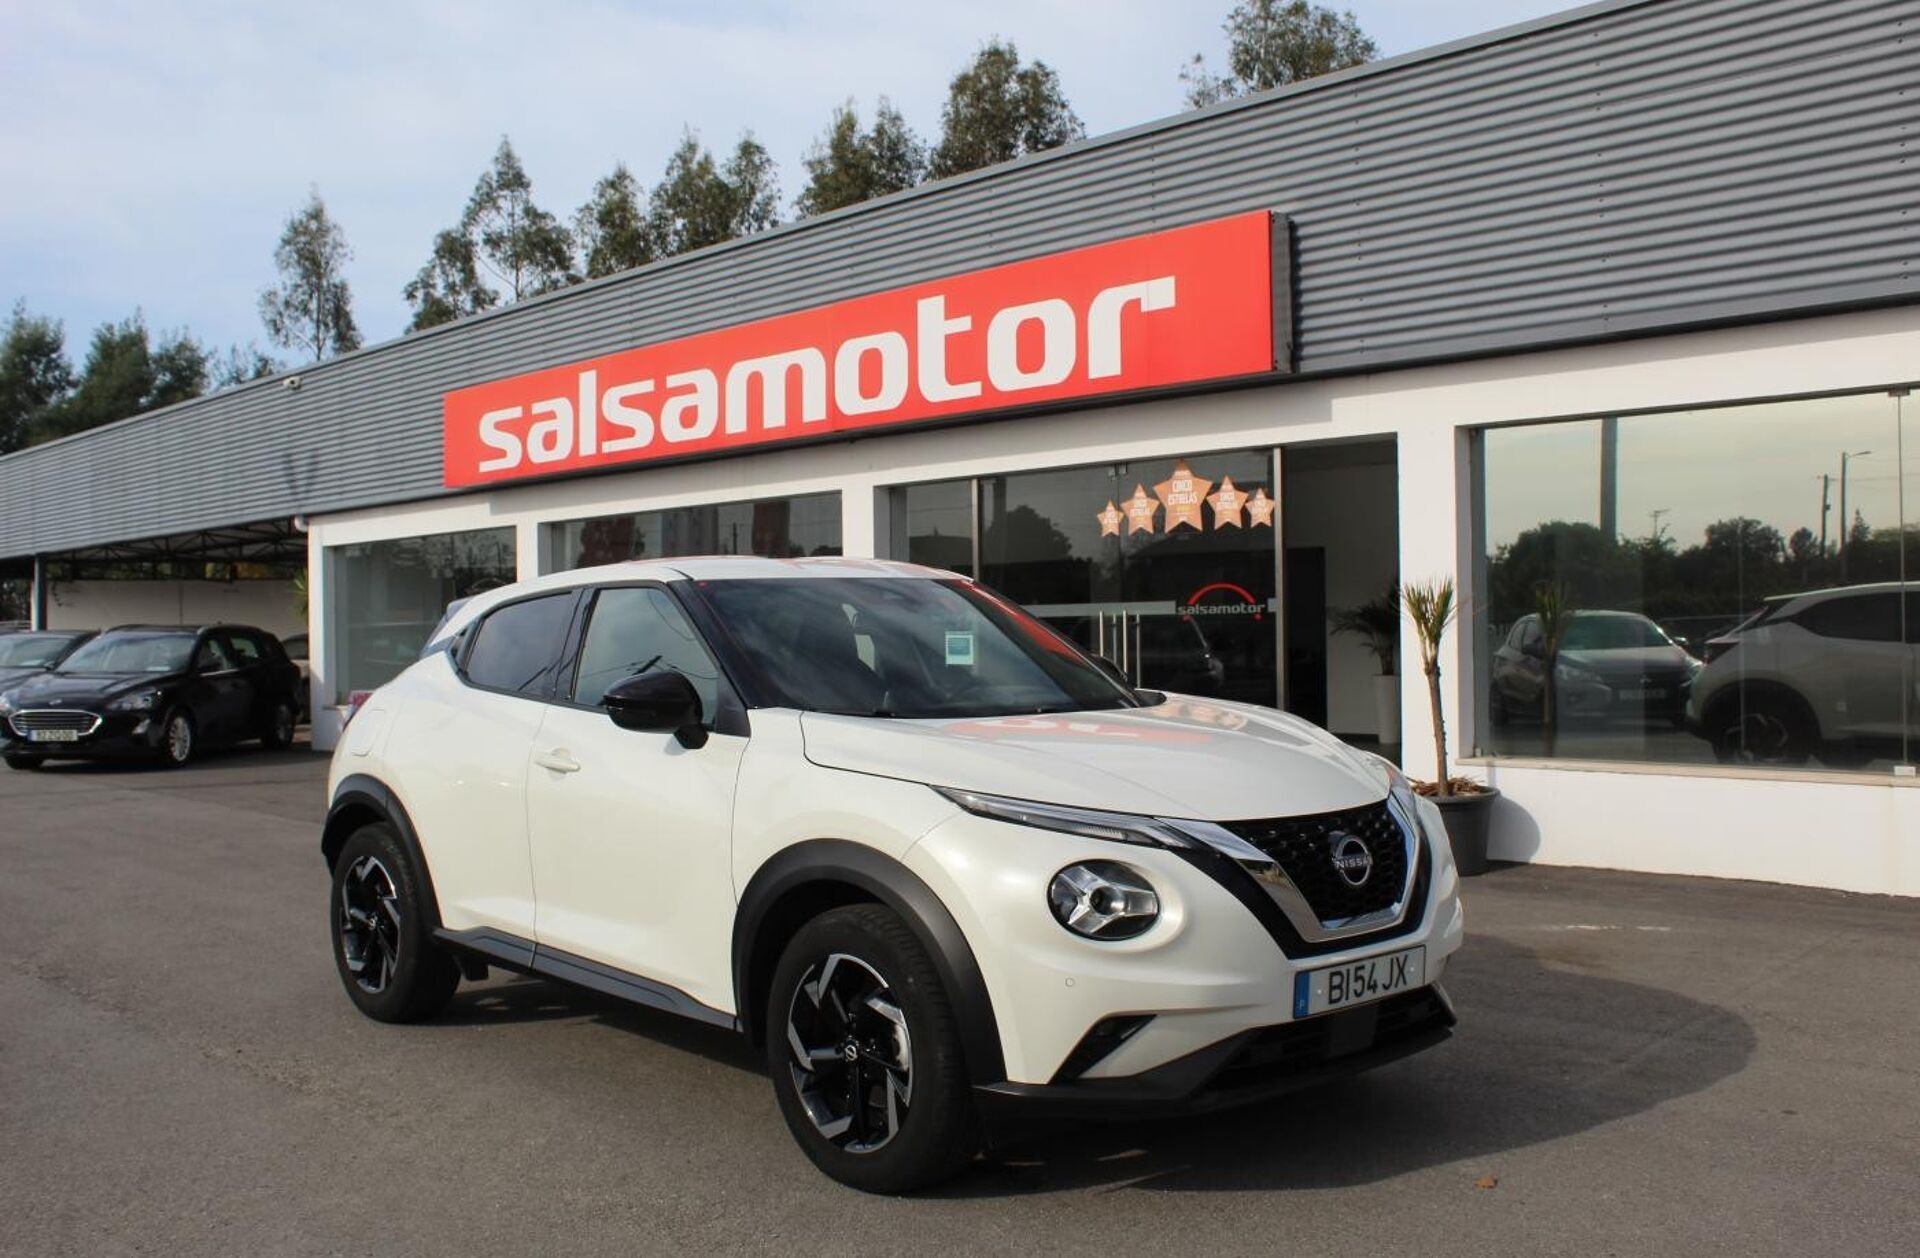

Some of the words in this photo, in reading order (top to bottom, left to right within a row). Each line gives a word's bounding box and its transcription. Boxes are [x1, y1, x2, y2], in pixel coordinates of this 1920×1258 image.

[478, 276, 1176, 472] salsamotor
[1172, 480, 1193, 492] CINCO
[1177, 603, 1265, 615] salsamotor
